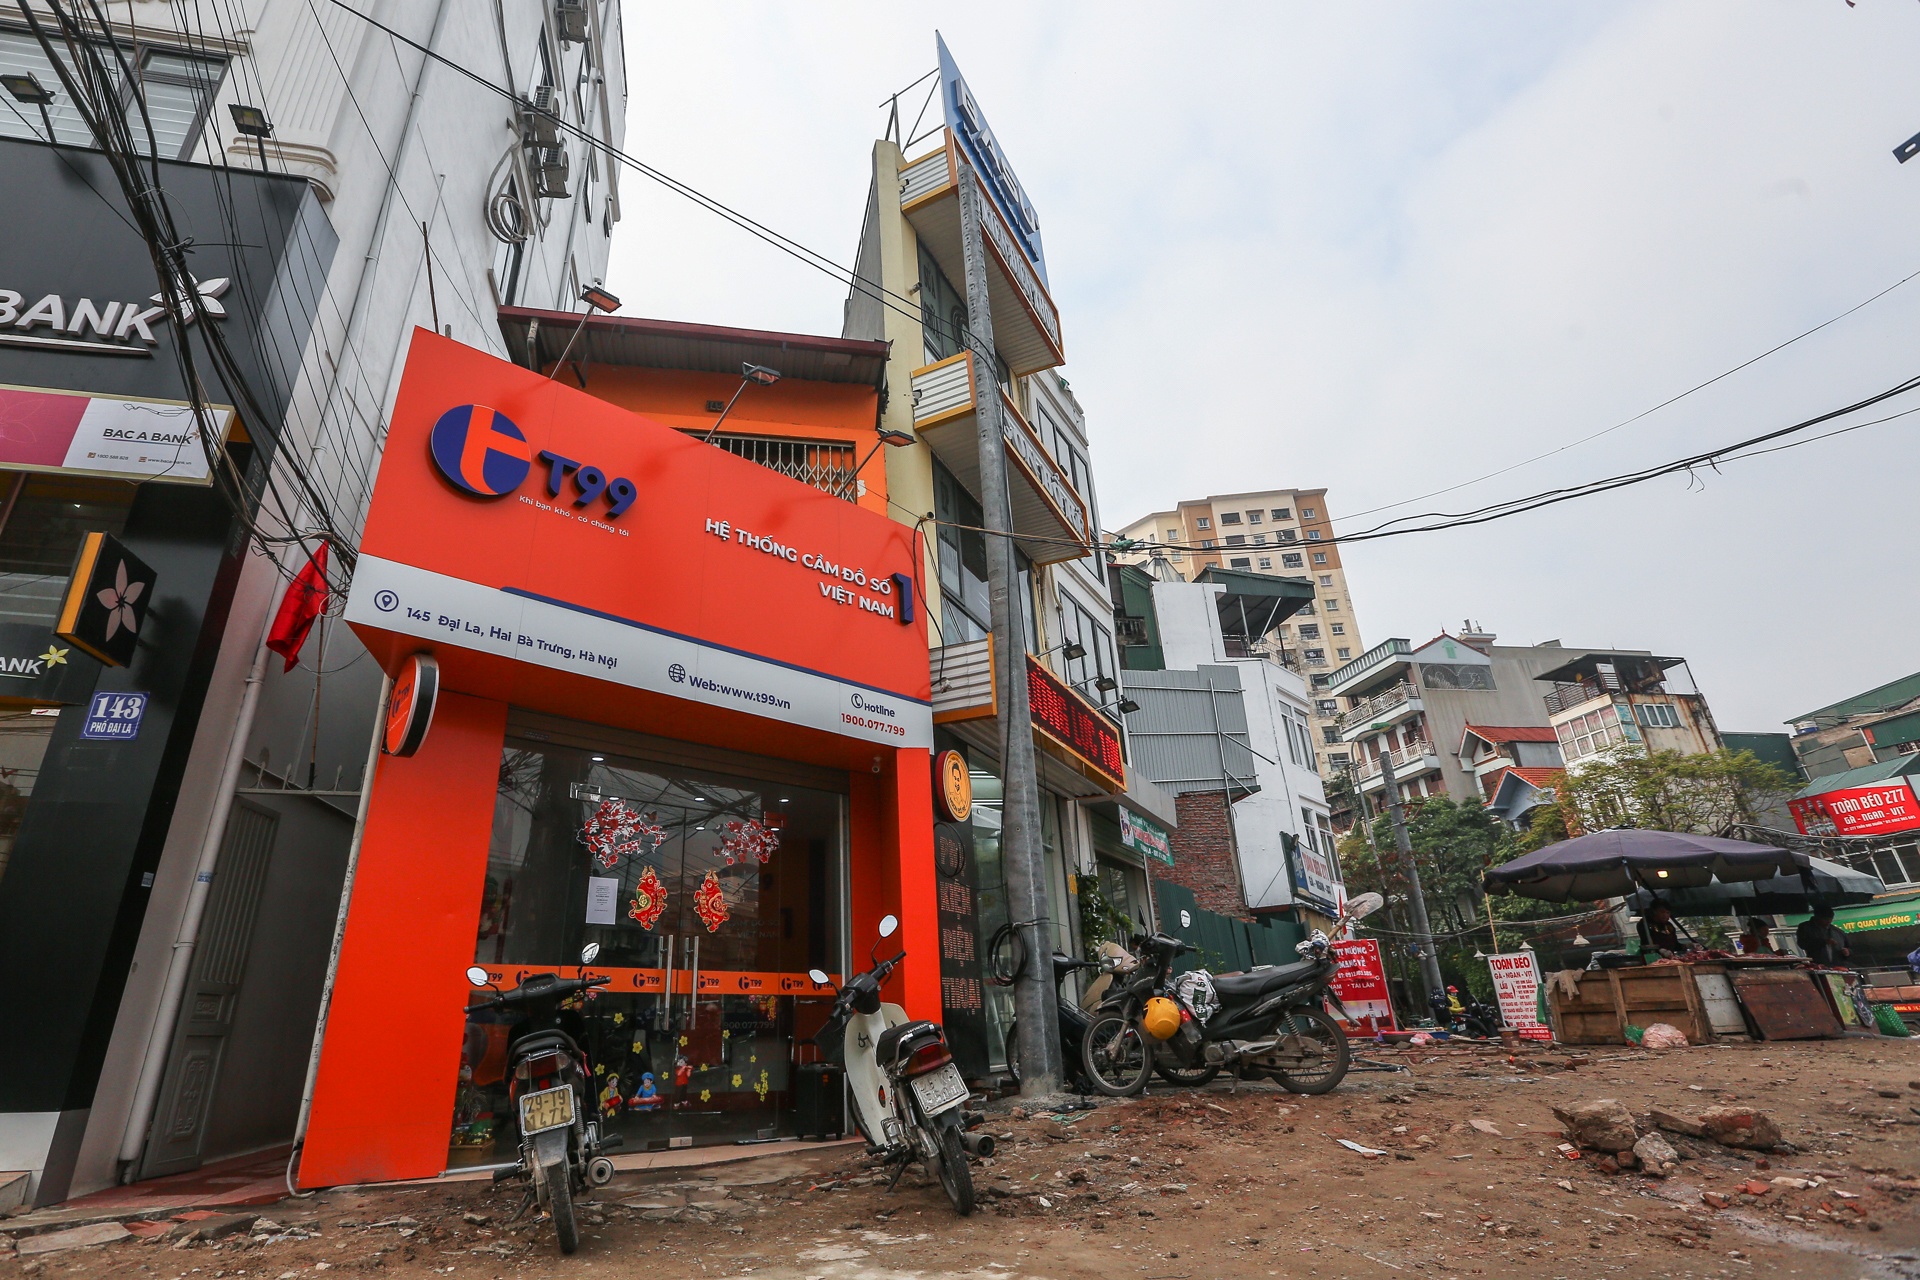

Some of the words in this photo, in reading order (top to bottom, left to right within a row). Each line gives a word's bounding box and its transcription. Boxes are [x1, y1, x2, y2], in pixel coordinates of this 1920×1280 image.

[103, 428, 135, 439] BAC
[136, 431, 148, 441] A
[151, 432, 193, 445] BANK
[537, 450, 637, 521] T99
[519, 495, 533, 505] Khi
[535, 500, 552, 511] bạn
[577, 515, 588, 523] có
[590, 519, 615, 533] chúng
[619, 528, 629, 537] tôi
[705, 517, 731, 541] HỆ
[735, 528, 798, 563] THỐNG
[802, 553, 839, 577] CẦM
[841, 567, 867, 587] ĐỒ
[870, 577, 892, 596] SỐ
[891, 572, 914, 626] 1
[818, 581, 856, 605] VIỆT
[859, 595, 894, 619] NAM
[406, 607, 431, 623] 145
[437, 614, 460, 632] Đại
[465, 621, 485, 637] La,
[489, 625, 512, 642] Hai
[517, 634, 534, 647] Bà
[537, 639, 576, 660] Trưng,
[579, 650, 595, 663] Hà
[598, 654, 618, 670] Nội
[688, 674, 791, 711] Web:www.t99.vn
[92, 696, 142, 720] 143
[864, 702, 896, 718] Hotline
[90, 719, 108, 733] PHỐ
[107, 721, 122, 735] ĐẠI
[122, 723, 132, 734] LA
[841, 712, 905, 737] 1900.077.799
[1830, 797, 1861, 815] TOÀN
[1860, 791, 1883, 809] BÉO
[1882, 788, 1906, 805] 277
[1844, 815, 1856, 825] GÀ
[1861, 809, 1885, 821] NGAN
[1890, 806, 1906, 817] VỊT
[940, 878, 971, 920] KIỆN
[1843, 922, 1856, 932] VỊT
[1857, 918, 1878, 928] QUAY
[1879, 914, 1911, 926] NƯỚNG
[1490, 956, 1514, 970] TOÀN
[1514, 955, 1530, 969] BÉO
[488, 972, 503, 982] T99
[647, 976, 660, 985] T99
[707, 978, 720, 986] T99
[750, 979, 762, 987] T99
[1494, 971, 1503, 979] GÀ
[1505, 971, 1522, 979] NGAN
[1523, 970, 1533, 979] VỊT
